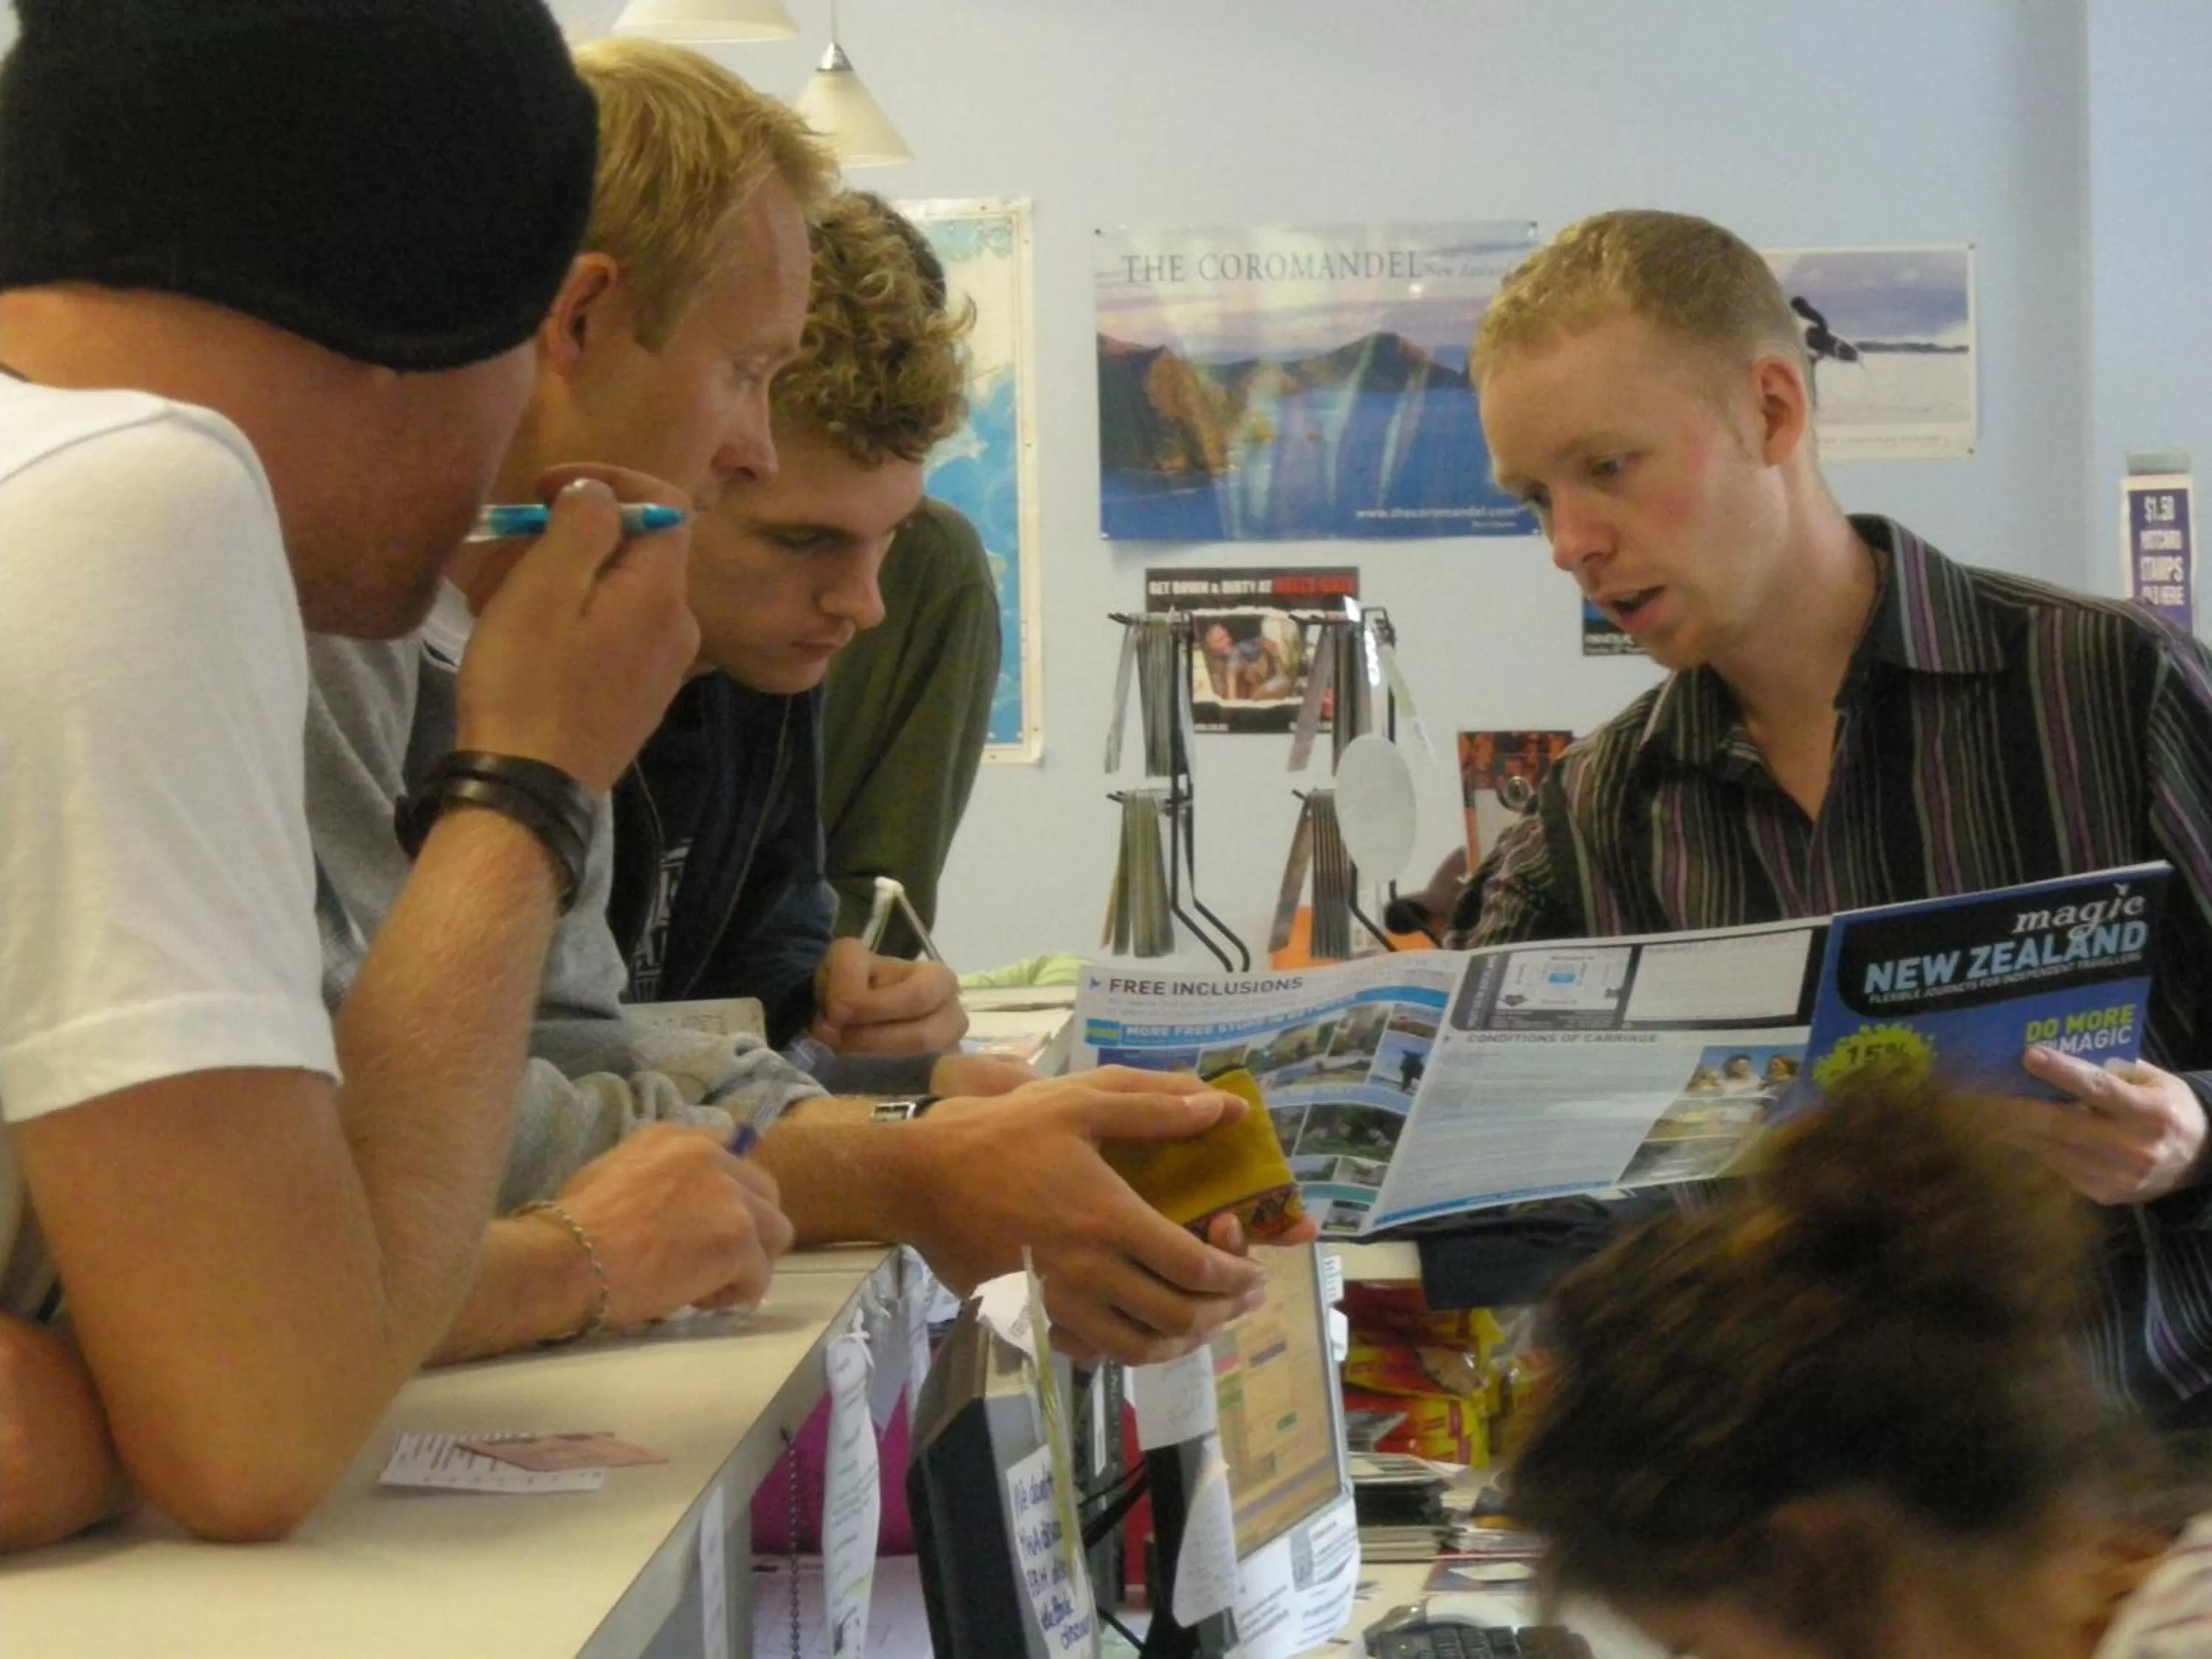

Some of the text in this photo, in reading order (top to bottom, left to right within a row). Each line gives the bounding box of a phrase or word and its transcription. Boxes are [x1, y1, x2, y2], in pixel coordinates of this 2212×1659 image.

[1122, 254, 1183, 284] THE
[1198, 250, 1423, 282] COROMANDEL
[2012, 883, 2144, 941] magic
[1863, 919, 2149, 995] NEW ZEALAND
[1110, 976, 1304, 996] FREE INCLUSIONS
[1467, 1032, 1658, 1044] CONDITIONS OF CARRIAGE
[2025, 1004, 2138, 1042] DO MORE
[2059, 1026, 2133, 1054] MAGIC
